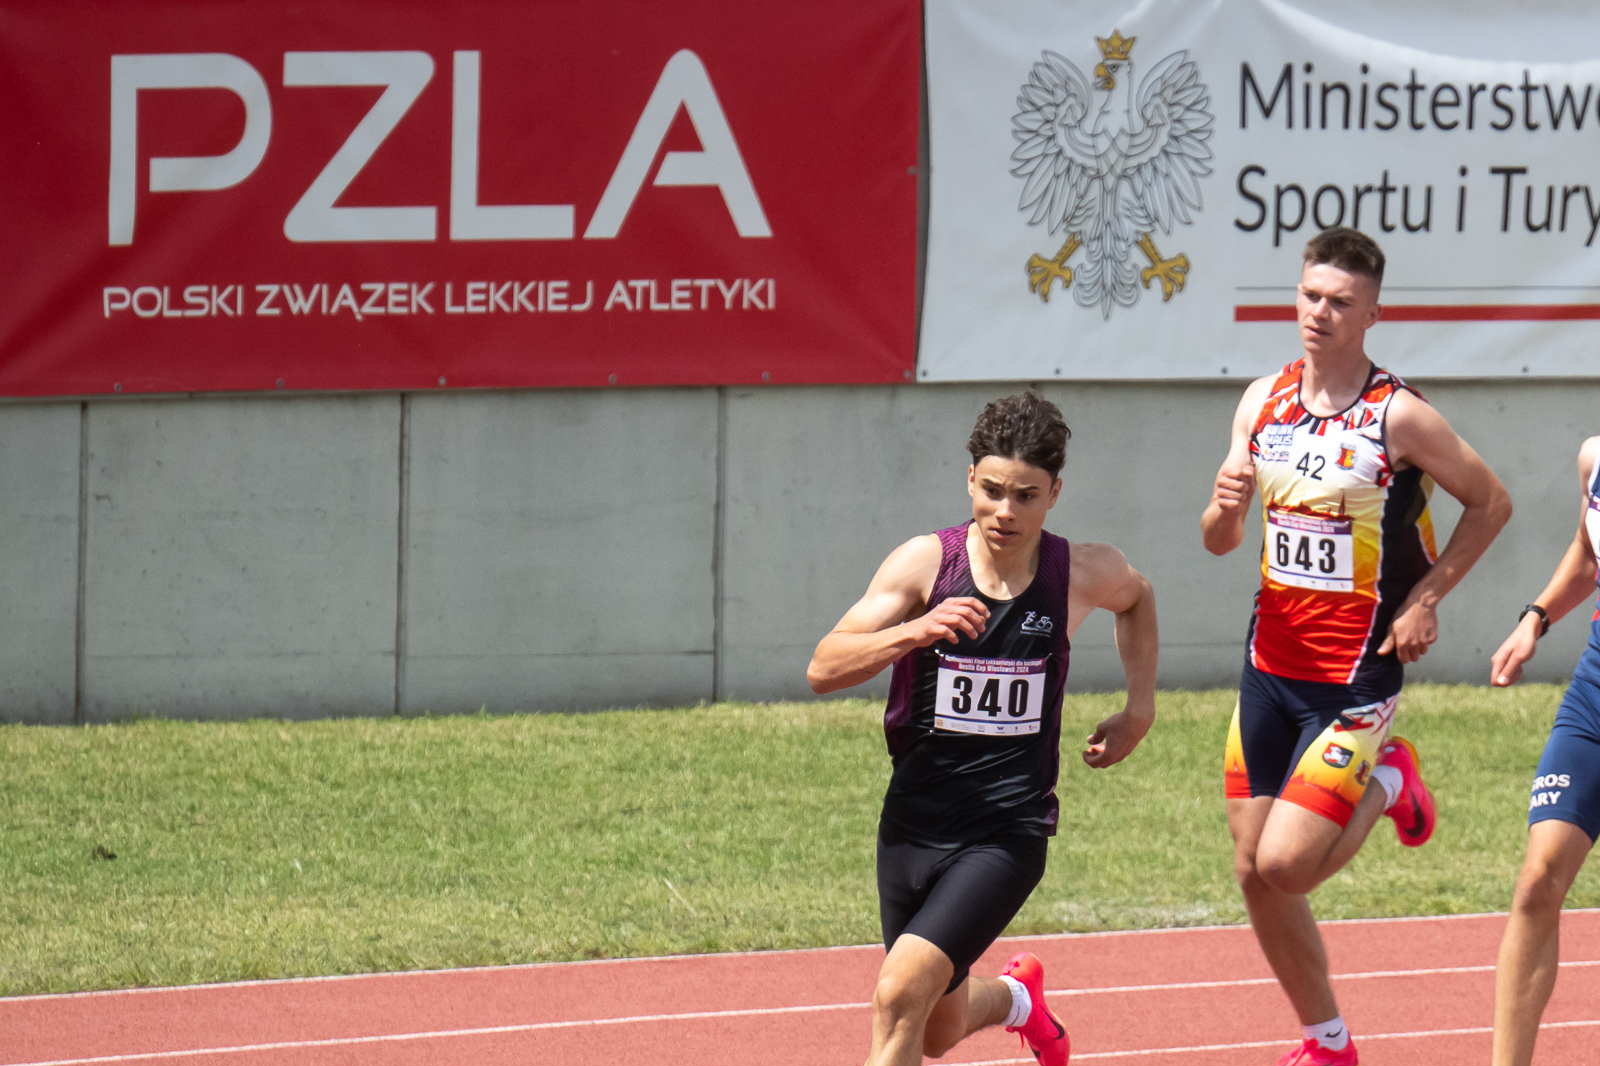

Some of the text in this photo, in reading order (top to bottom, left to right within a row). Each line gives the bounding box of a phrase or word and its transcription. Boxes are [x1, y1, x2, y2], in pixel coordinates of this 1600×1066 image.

[109, 49, 773, 246] PZLA
[1234, 164, 1434, 247] Sportu
[1456, 165, 1469, 232] i
[103, 278, 776, 321] POLSKI ZWIĄZEK LEKKIEJ ATLETYKI
[1296, 452, 1326, 481] 42
[1276, 531, 1336, 574] 643
[952, 675, 1030, 717] 340
[1528, 791, 1561, 811] ARY
[1531, 773, 1571, 792] ROS
